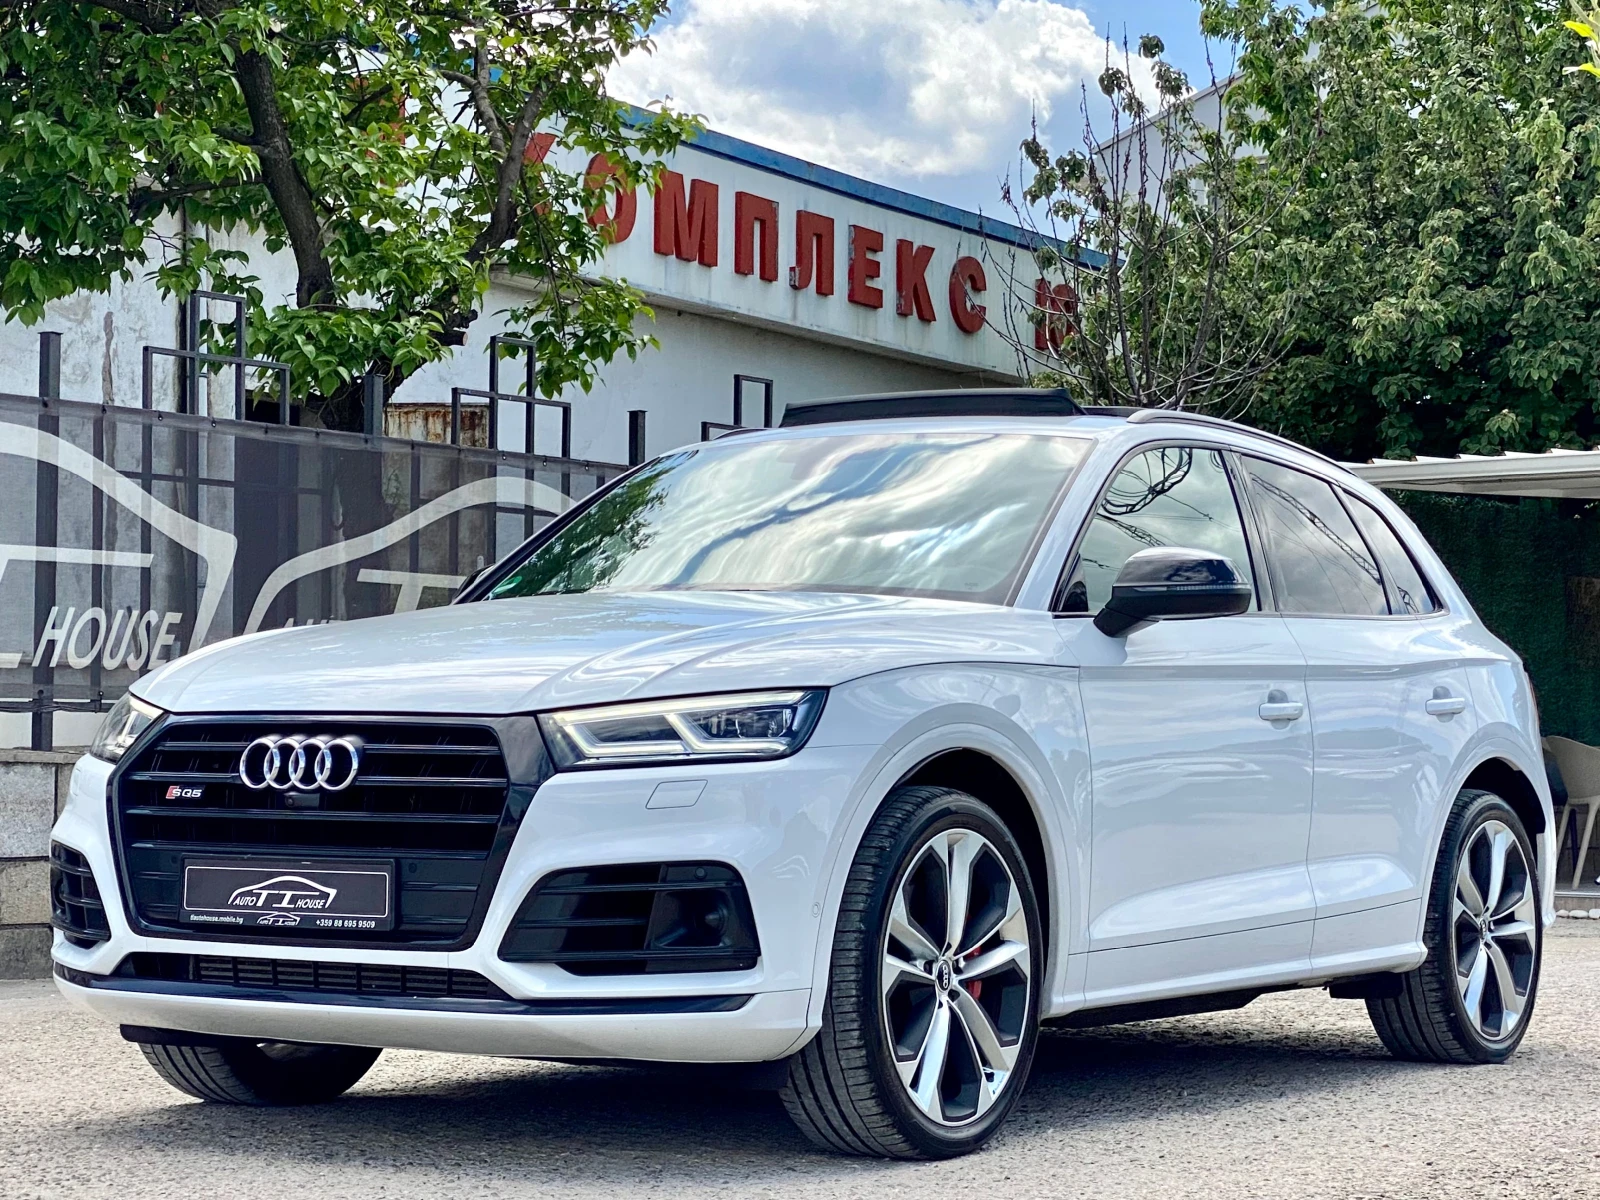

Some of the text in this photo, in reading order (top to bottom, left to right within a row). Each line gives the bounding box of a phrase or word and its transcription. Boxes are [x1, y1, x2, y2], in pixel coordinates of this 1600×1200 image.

[32, 605, 183, 672] HOUSE
[169, 786, 203, 799] SQ5
[233, 896, 257, 906] AUTO
[295, 898, 326, 909] HOUSE
[316, 919, 376, 929] +359 88 695 9509
